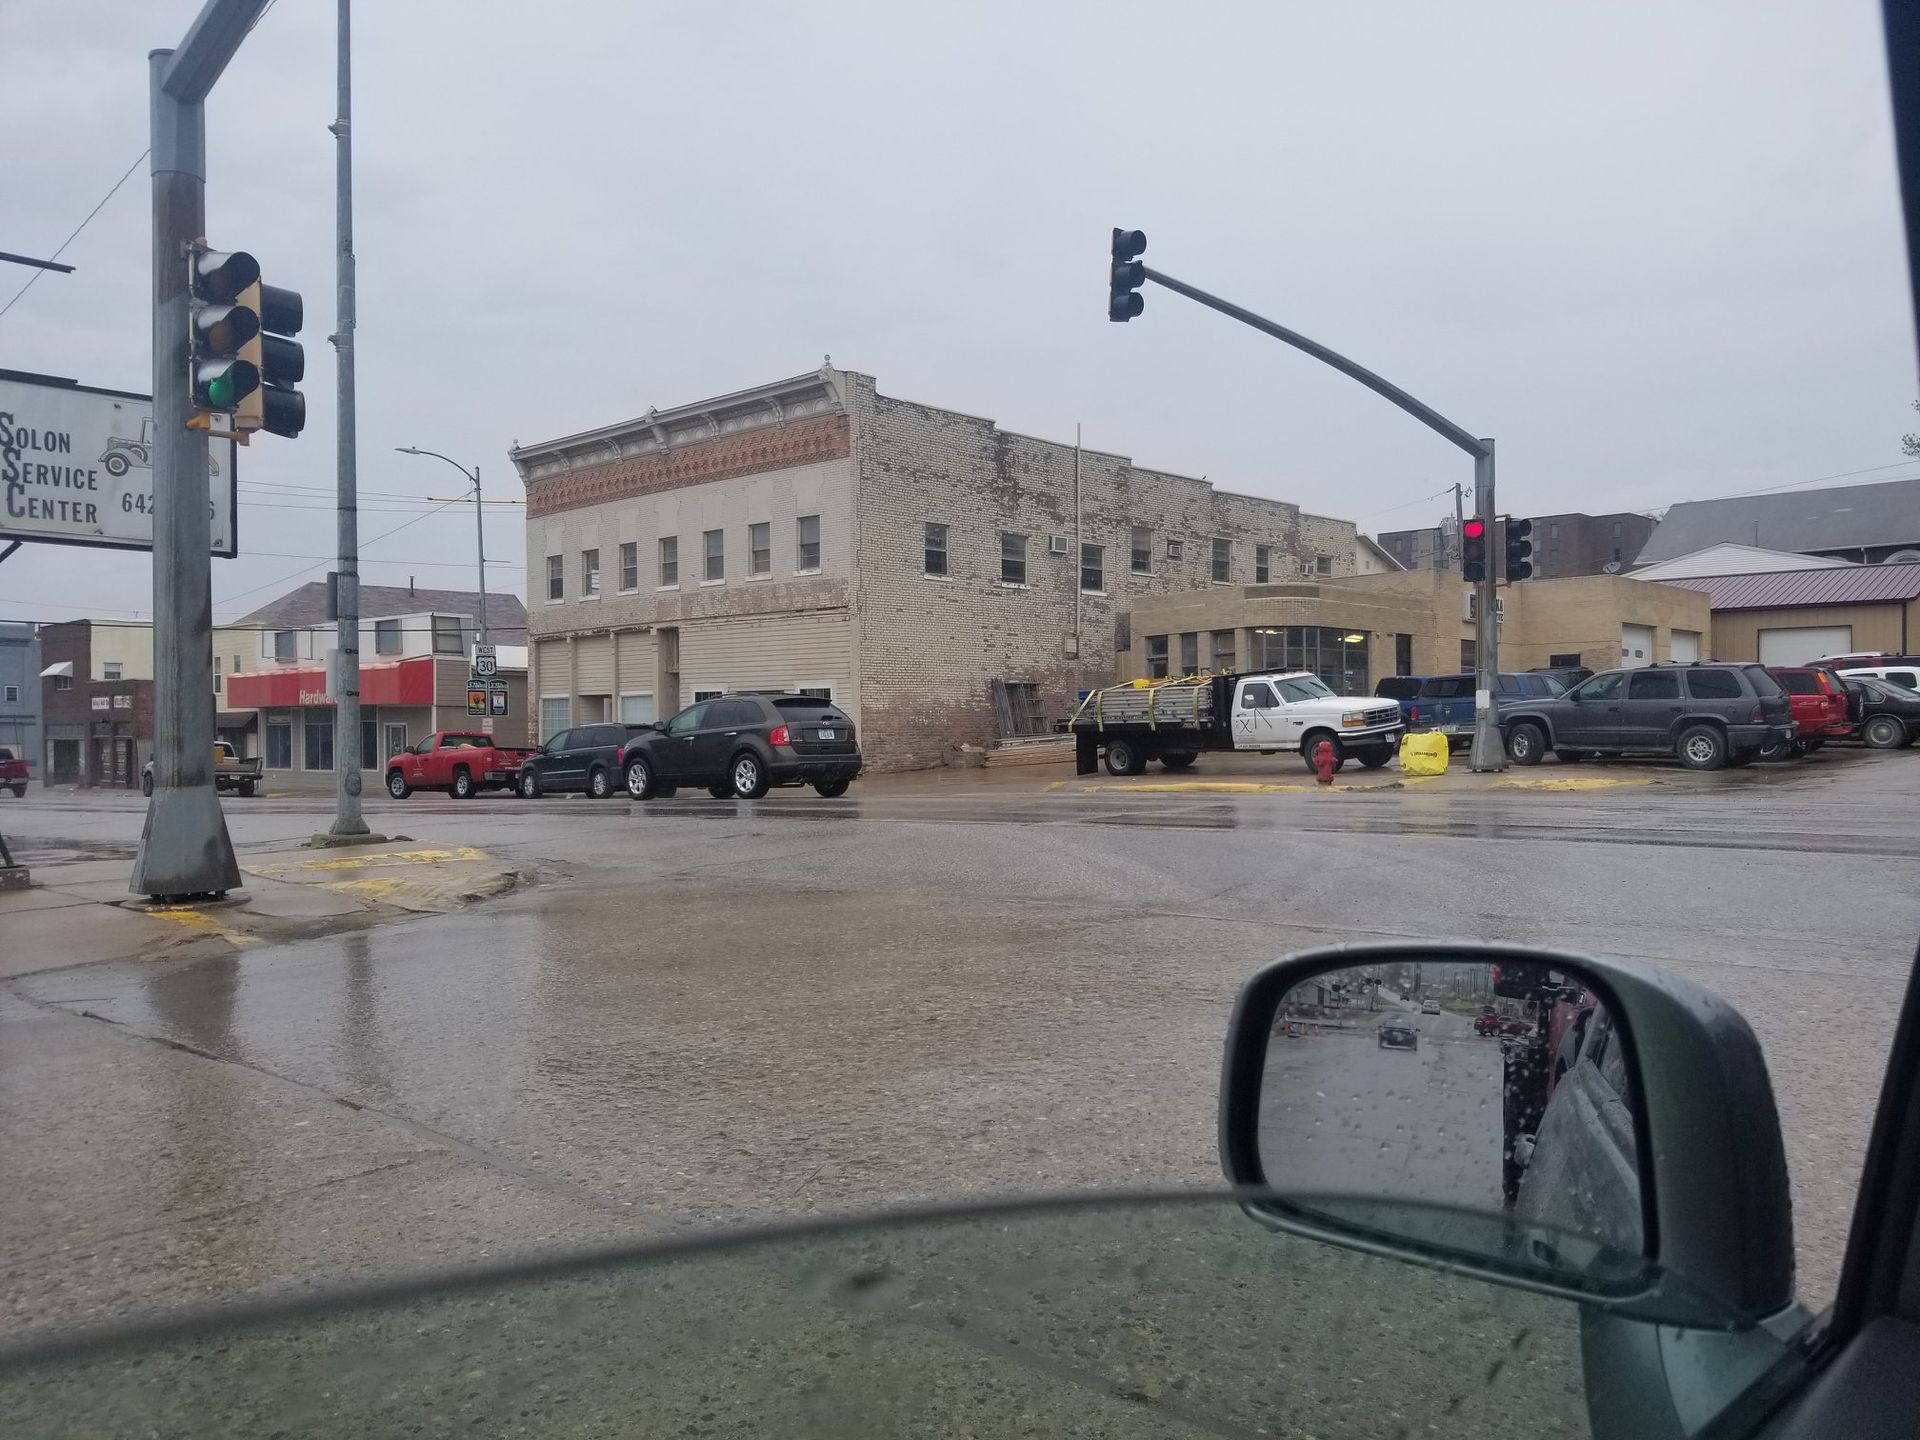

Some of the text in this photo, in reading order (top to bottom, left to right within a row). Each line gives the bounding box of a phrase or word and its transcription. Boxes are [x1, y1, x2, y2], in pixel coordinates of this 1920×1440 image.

[0, 411, 71, 454] SOLON
[2, 446, 98, 491] SERVICE
[6, 481, 97, 524] CENTER
[478, 646, 494, 654] WEST
[479, 660, 493, 672] 30
